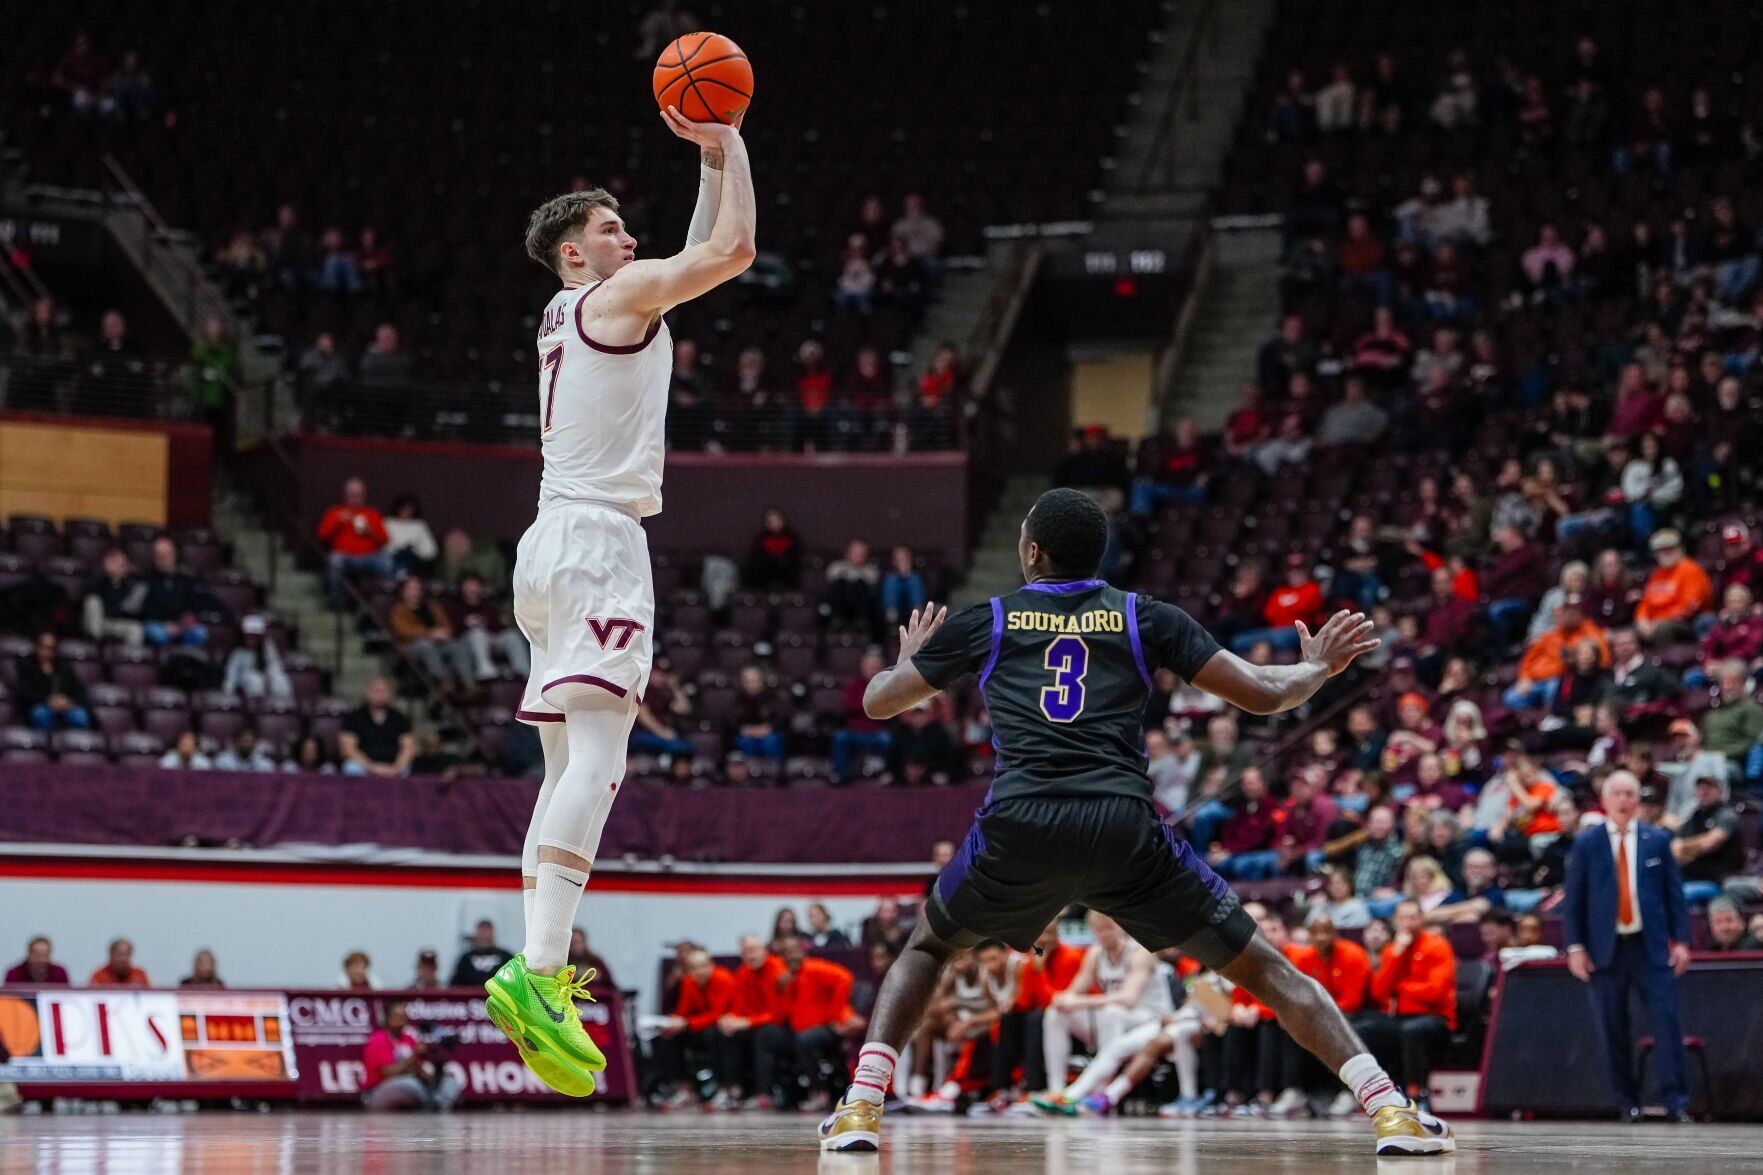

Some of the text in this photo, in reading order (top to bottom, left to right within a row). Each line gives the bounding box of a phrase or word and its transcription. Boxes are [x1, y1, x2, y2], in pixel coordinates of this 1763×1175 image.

[585, 617, 646, 651] VT
[1007, 610, 1124, 633] SOUMAORO
[1039, 634, 1089, 723] 3
